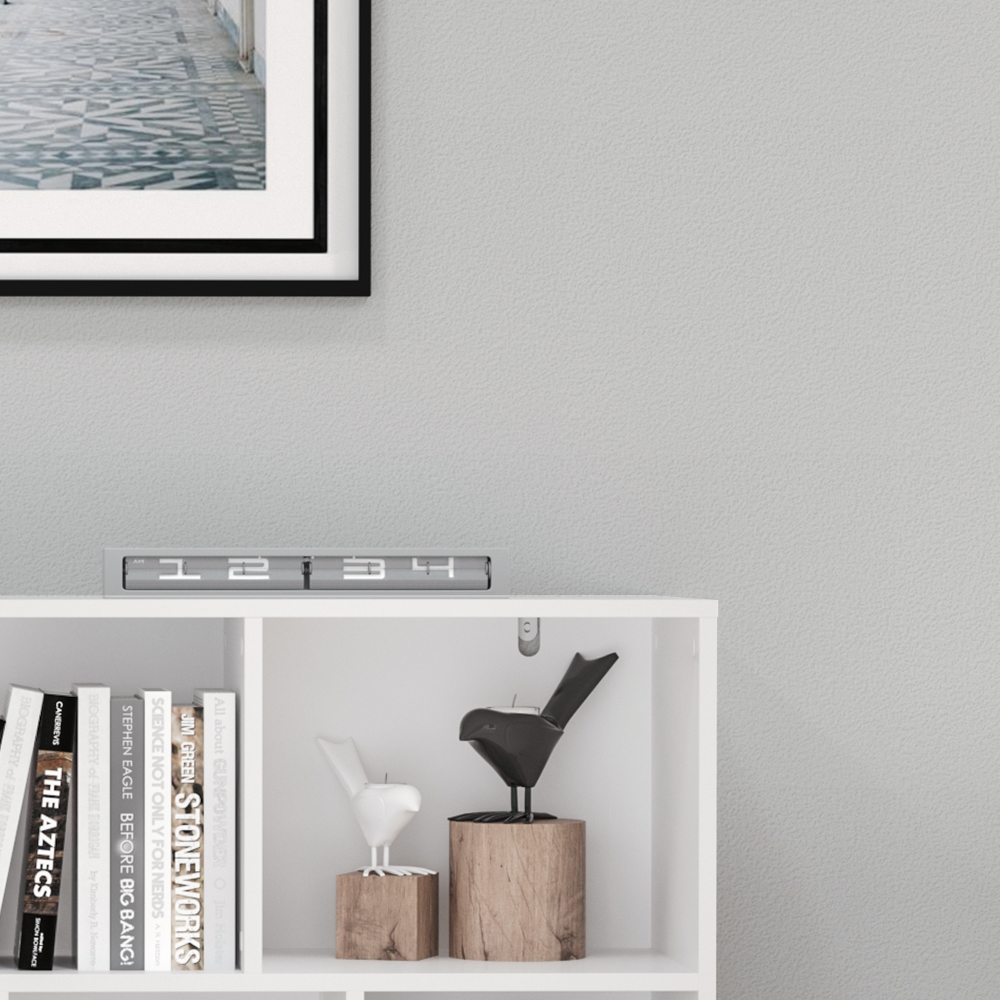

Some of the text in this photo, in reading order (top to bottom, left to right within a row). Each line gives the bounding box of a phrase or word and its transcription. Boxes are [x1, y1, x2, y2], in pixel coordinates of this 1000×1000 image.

[8, 696, 31, 767] BIOGRAPHY
[51, 701, 63, 745] CANERREVIS
[88, 693, 99, 765] BIOGRAPHY
[122, 705, 133, 800] STEPHEN EAGLE
[180, 713, 195, 784] JIM GREEN
[151, 697, 163, 918] SCIENCE NOT ONLY FOR NERDS
[212, 697, 226, 867] All about GUNPOWDER
[32, 766, 62, 898] THE AZTECS
[175, 793, 201, 965] STONEWORKS
[88, 883, 98, 919] Kimberly
[120, 813, 135, 966] BEFORE BIG BANG!
